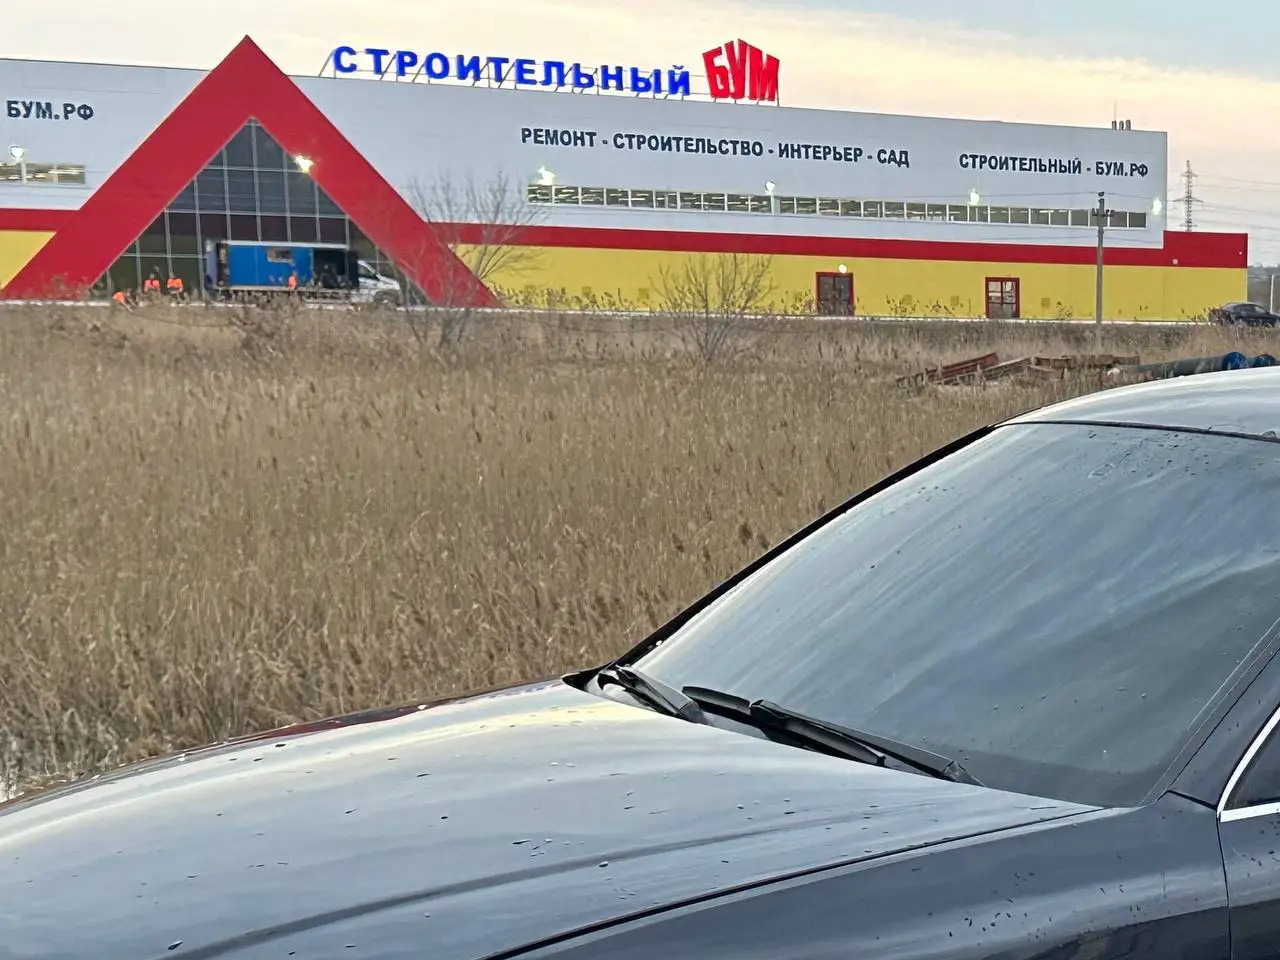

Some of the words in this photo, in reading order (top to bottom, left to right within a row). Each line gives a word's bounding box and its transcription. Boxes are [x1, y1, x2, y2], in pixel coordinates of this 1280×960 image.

[333, 46, 691, 96] СТРОИТЕЛЬНЫЙ
[702, 38, 780, 101] БУМ
[6, 99, 94, 120] БУМ.РФ
[521, 127, 597, 148] РЕМОНТ
[612, 133, 764, 157] СТРОИТЕЛЬСТВО
[778, 142, 863, 163] ИНТЕРЬЕР
[876, 148, 910, 168] САД
[958, 153, 1082, 175] СТРОИТЕЛЬНЫЙ
[1095, 161, 1149, 177] БУМ.РФ
